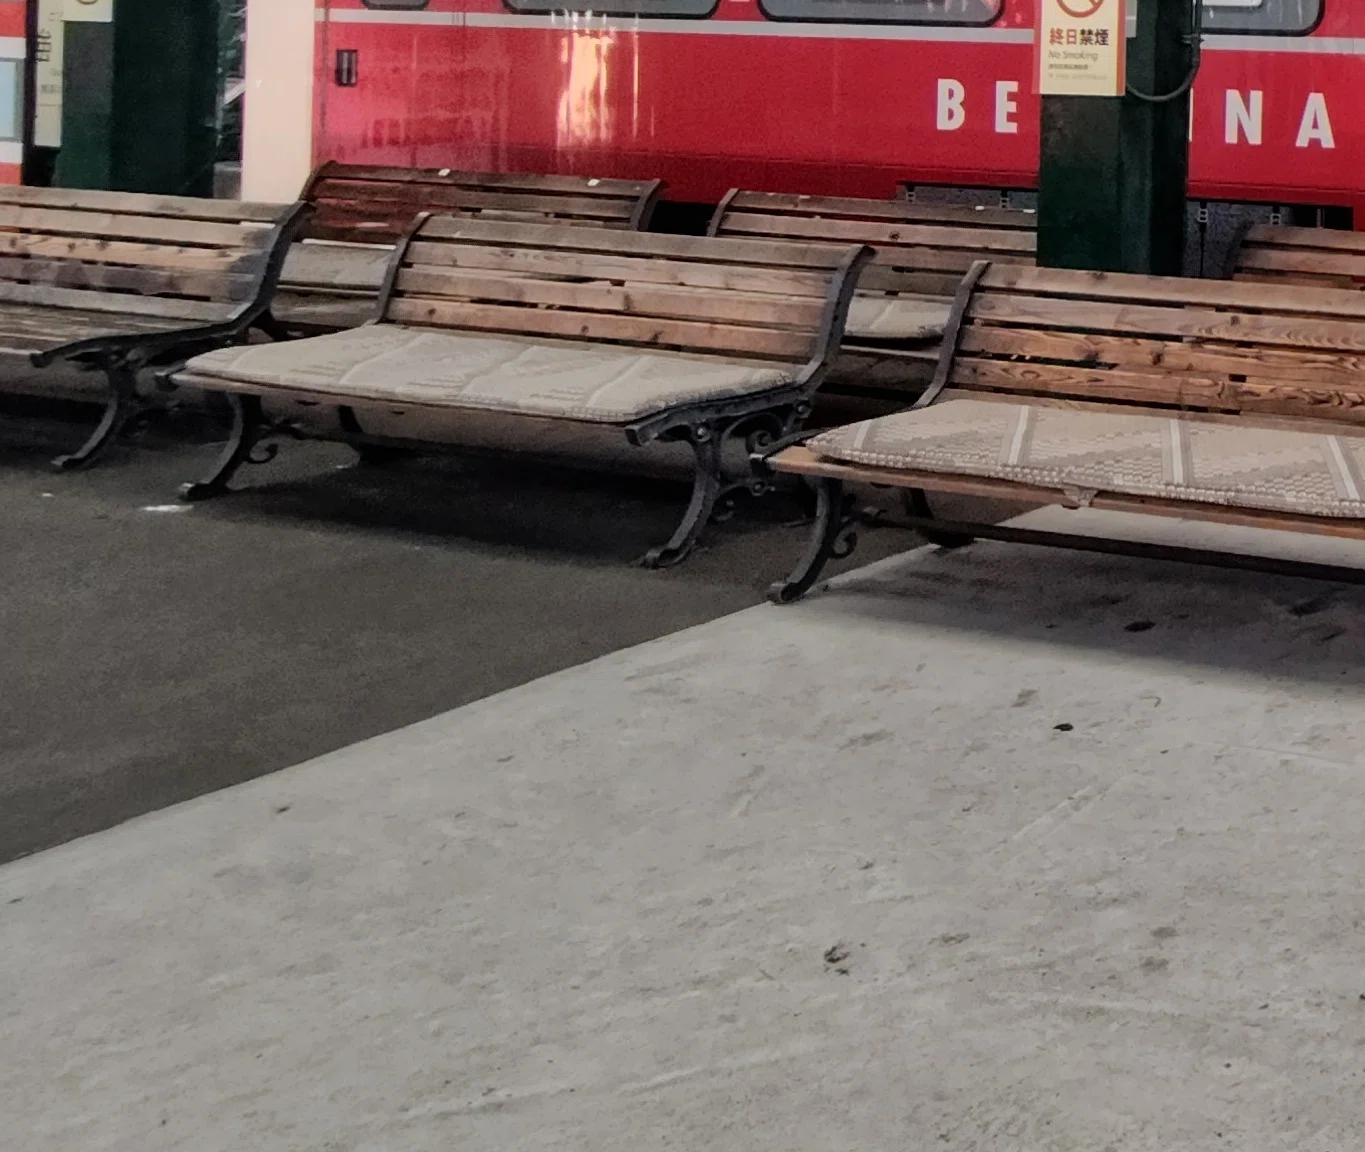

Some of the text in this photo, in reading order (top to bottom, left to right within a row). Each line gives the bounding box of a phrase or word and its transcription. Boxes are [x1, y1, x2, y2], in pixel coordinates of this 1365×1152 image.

[1049, 28, 1109, 46] 終日禁煙
[1048, 50, 1098, 63] No Smoking
[936, 78, 1336, 149] BENA
